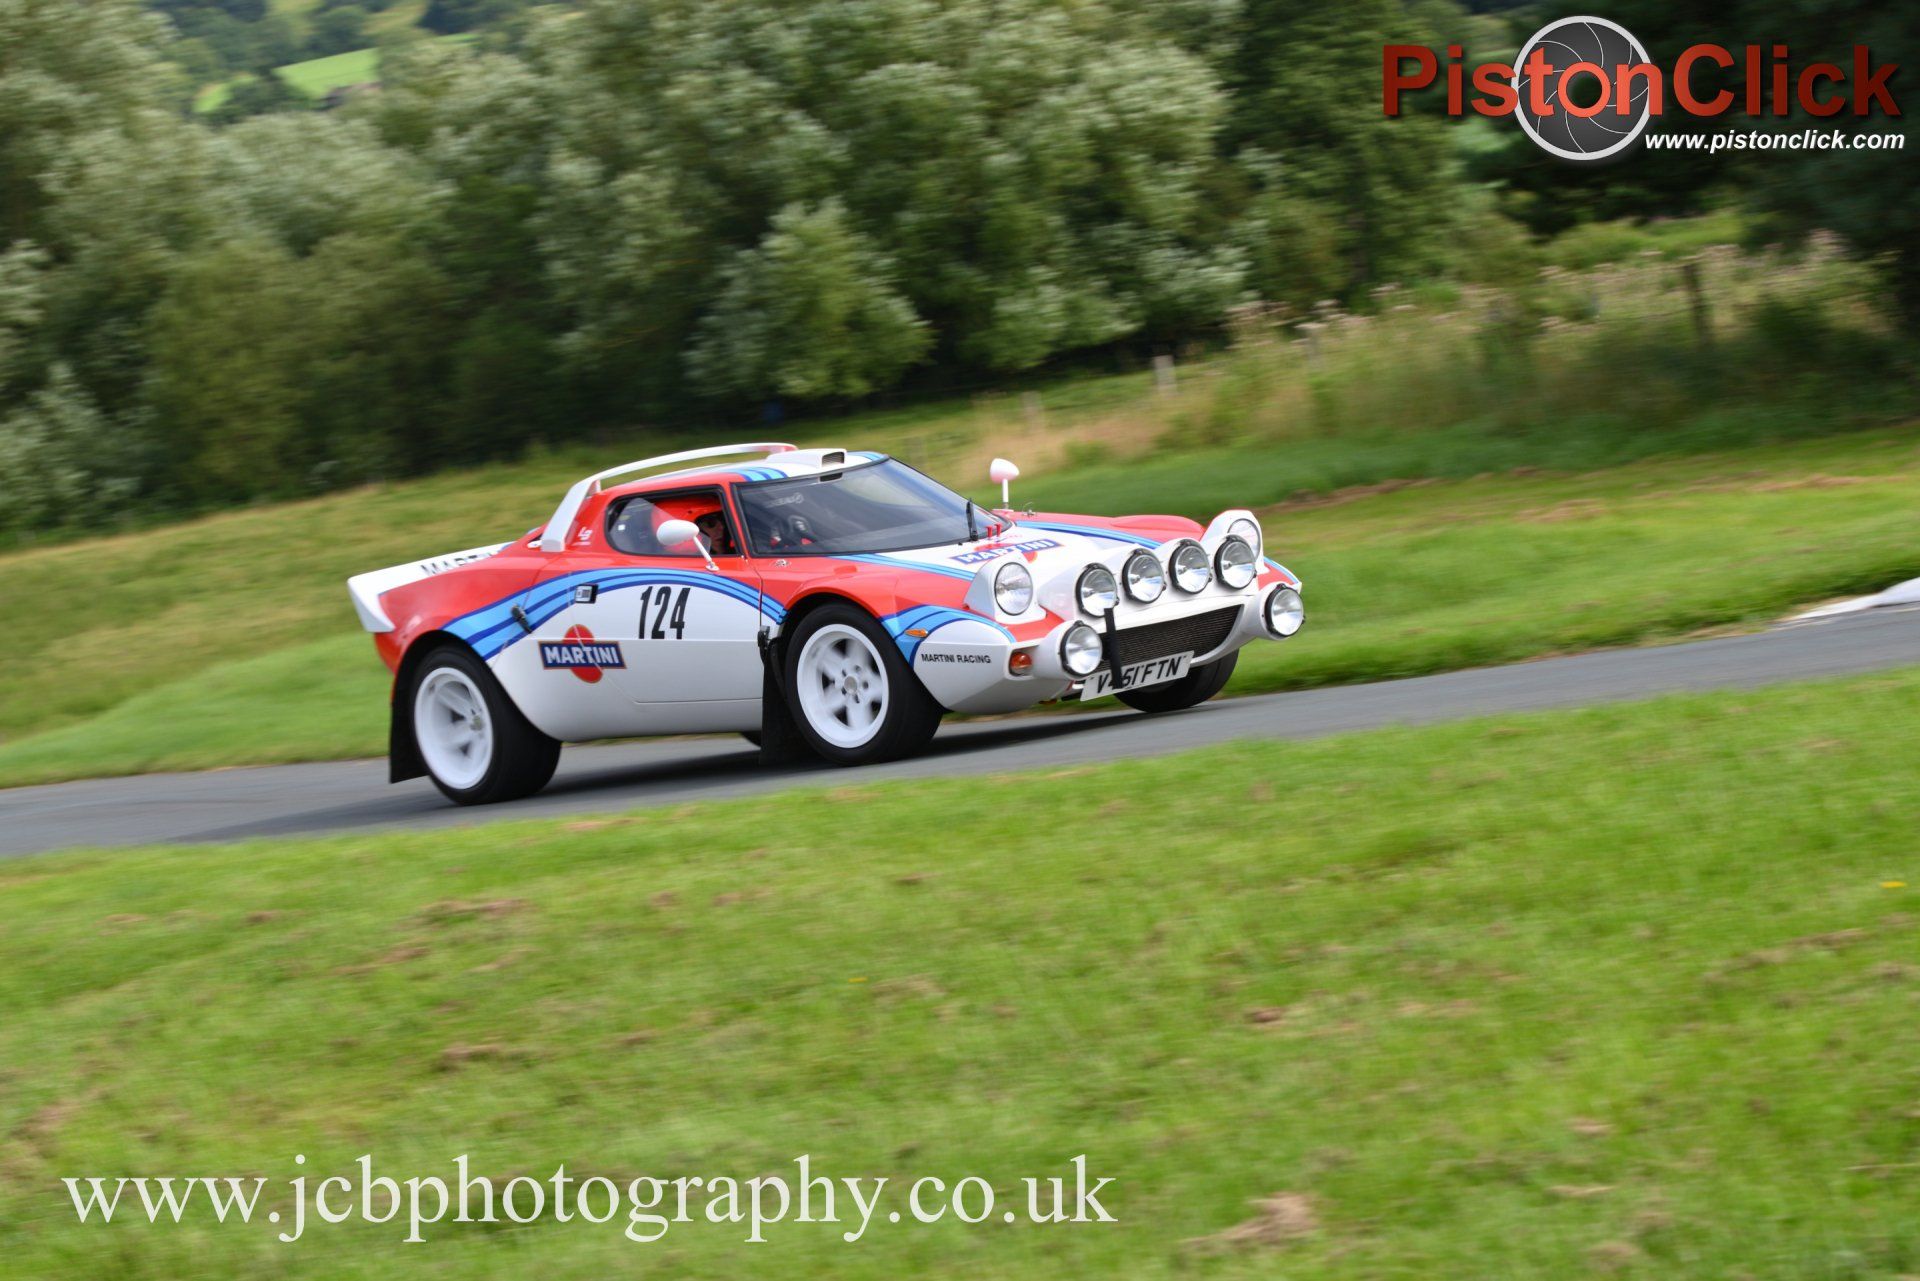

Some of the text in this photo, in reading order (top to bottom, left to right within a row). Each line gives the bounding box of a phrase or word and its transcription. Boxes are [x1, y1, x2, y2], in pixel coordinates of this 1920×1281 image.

[639, 586, 691, 639] 124
[544, 646, 620, 664] MARTINI
[921, 654, 991, 663] MARTINI RACING
[1140, 656, 1182, 683] FTN
